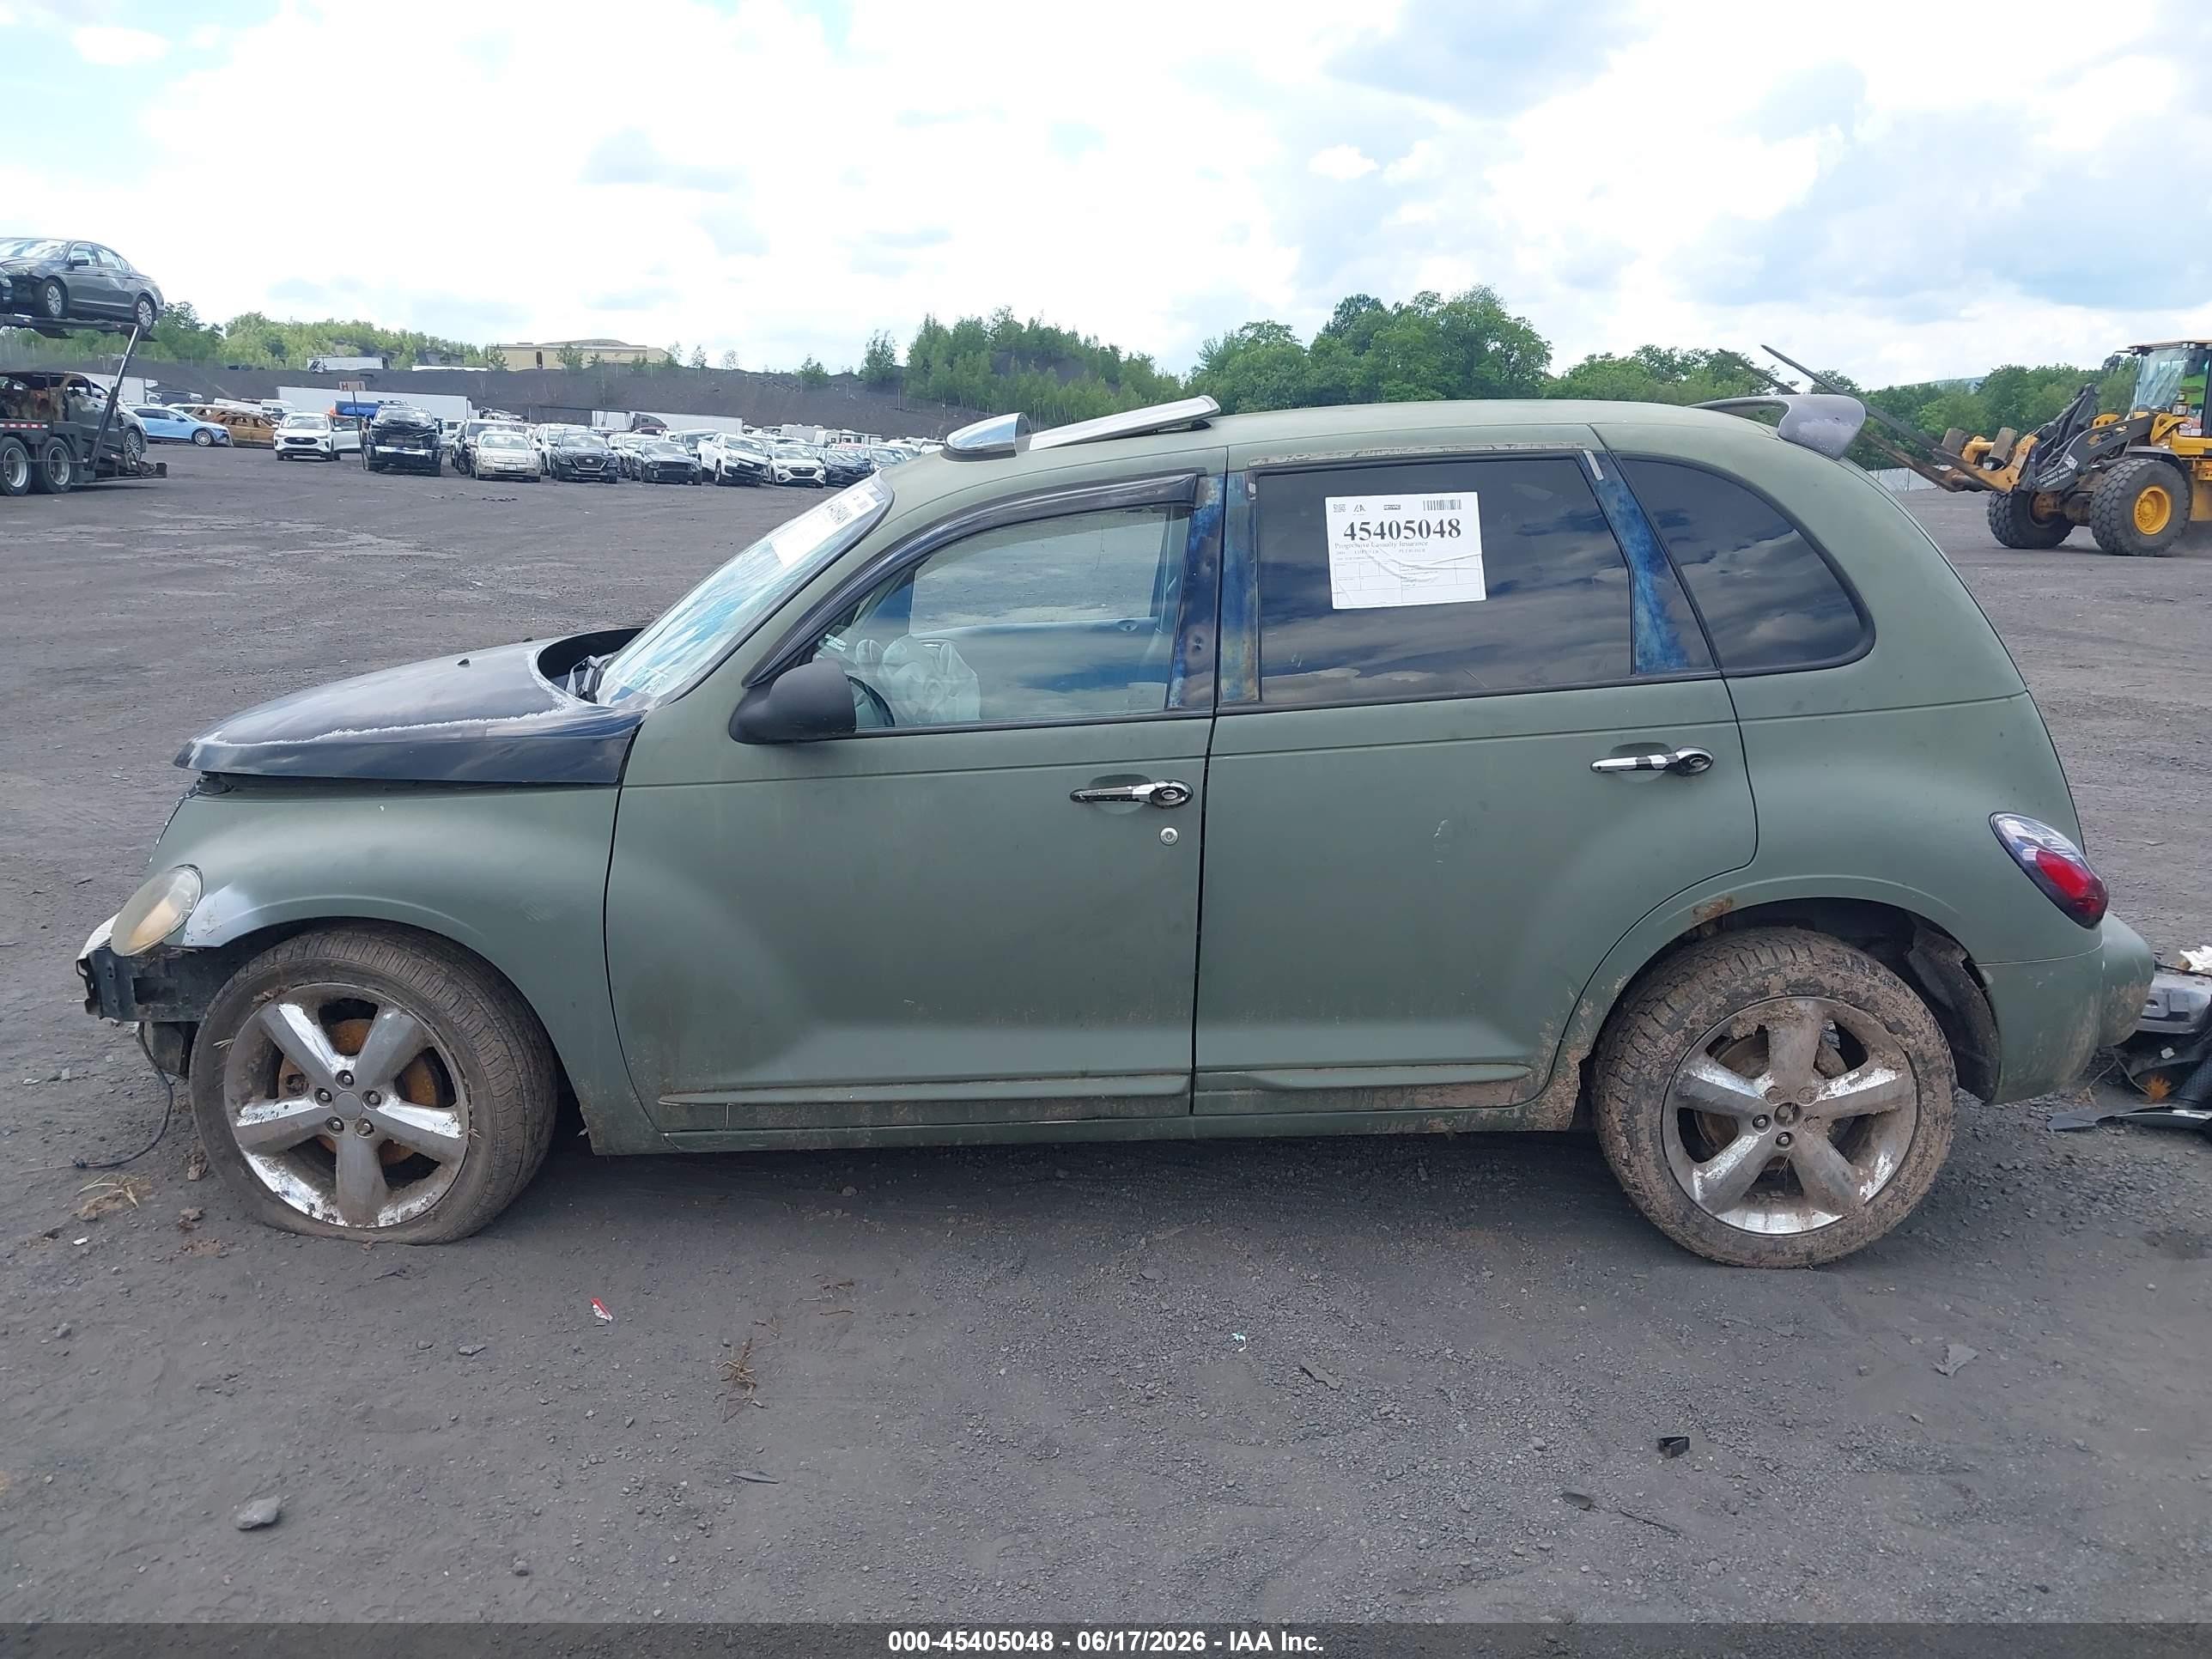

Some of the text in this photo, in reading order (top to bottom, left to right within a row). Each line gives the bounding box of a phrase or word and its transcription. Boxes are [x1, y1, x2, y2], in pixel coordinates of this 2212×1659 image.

[2043, 471, 2071, 487] UNDER MAST
[1344, 519, 1462, 542] 45405048
